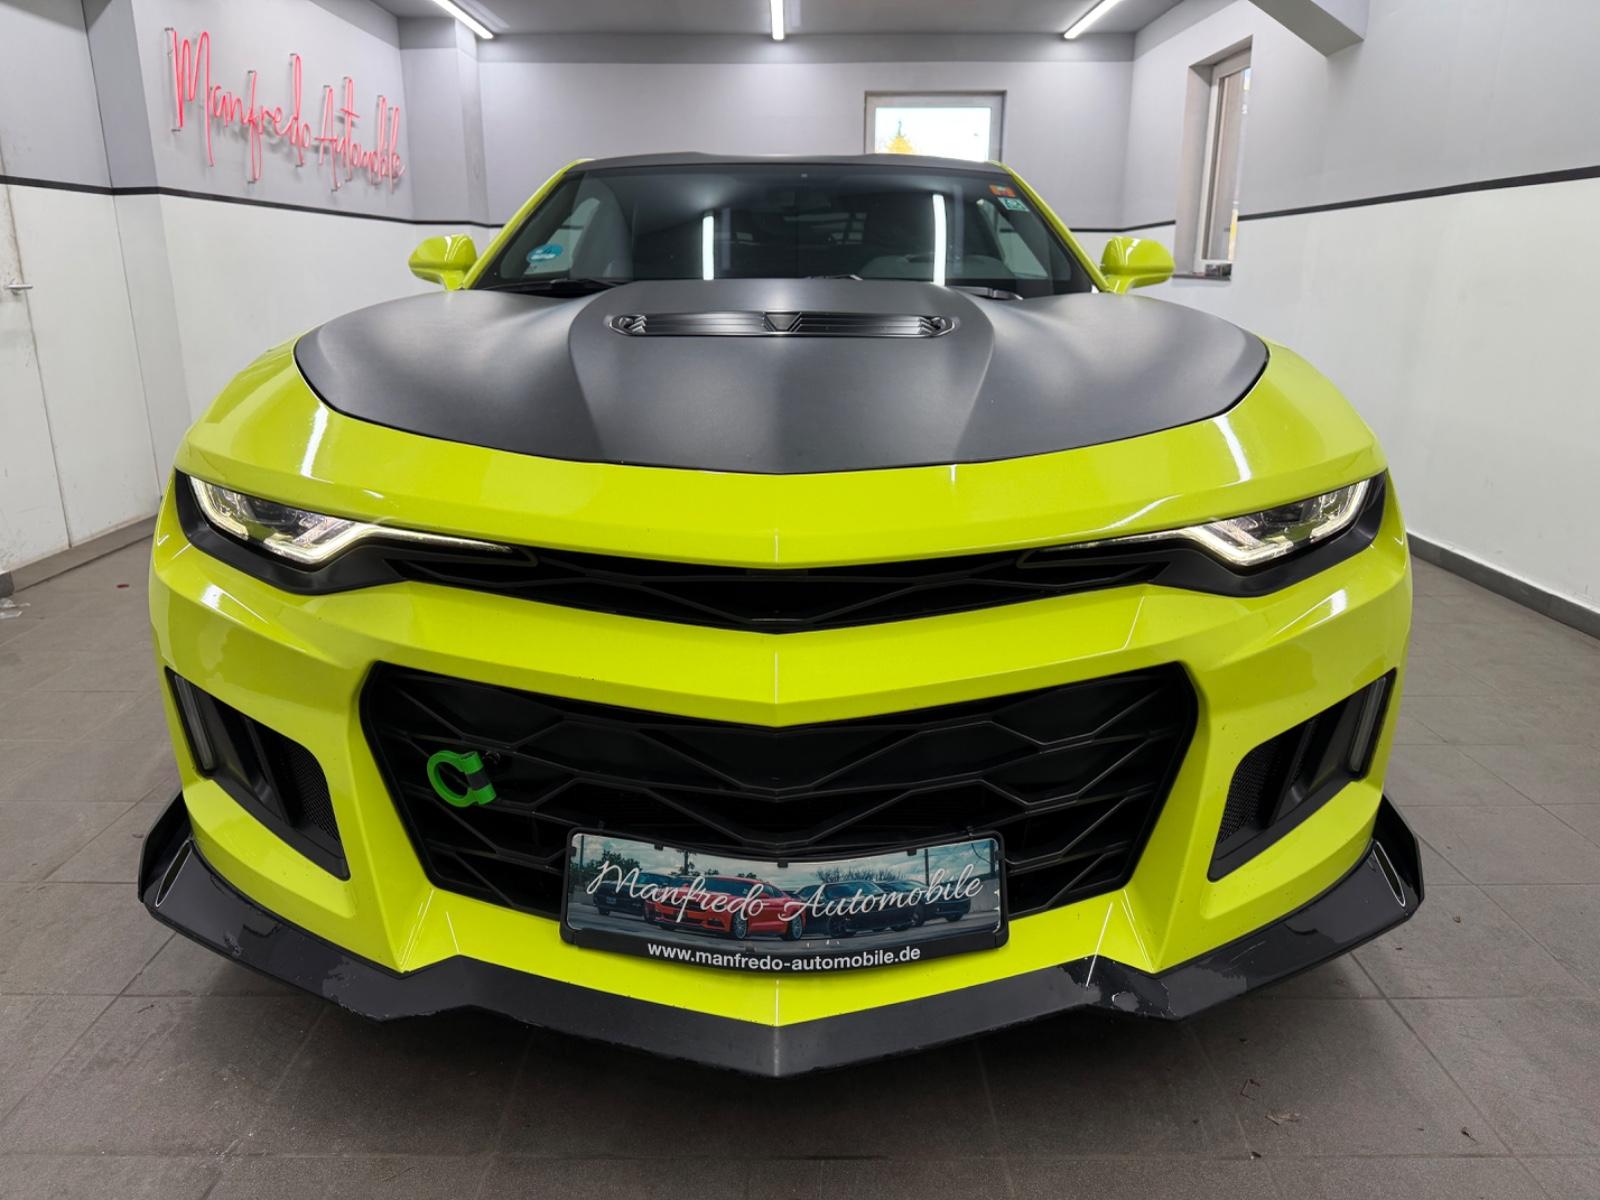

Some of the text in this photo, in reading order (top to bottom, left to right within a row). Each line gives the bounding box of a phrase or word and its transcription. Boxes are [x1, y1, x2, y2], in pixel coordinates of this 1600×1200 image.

[172, 31, 310, 181] Manfredo
[586, 861, 984, 923] Manfredo Automobile
[647, 943, 921, 971] www.manfredo-automobile.de
